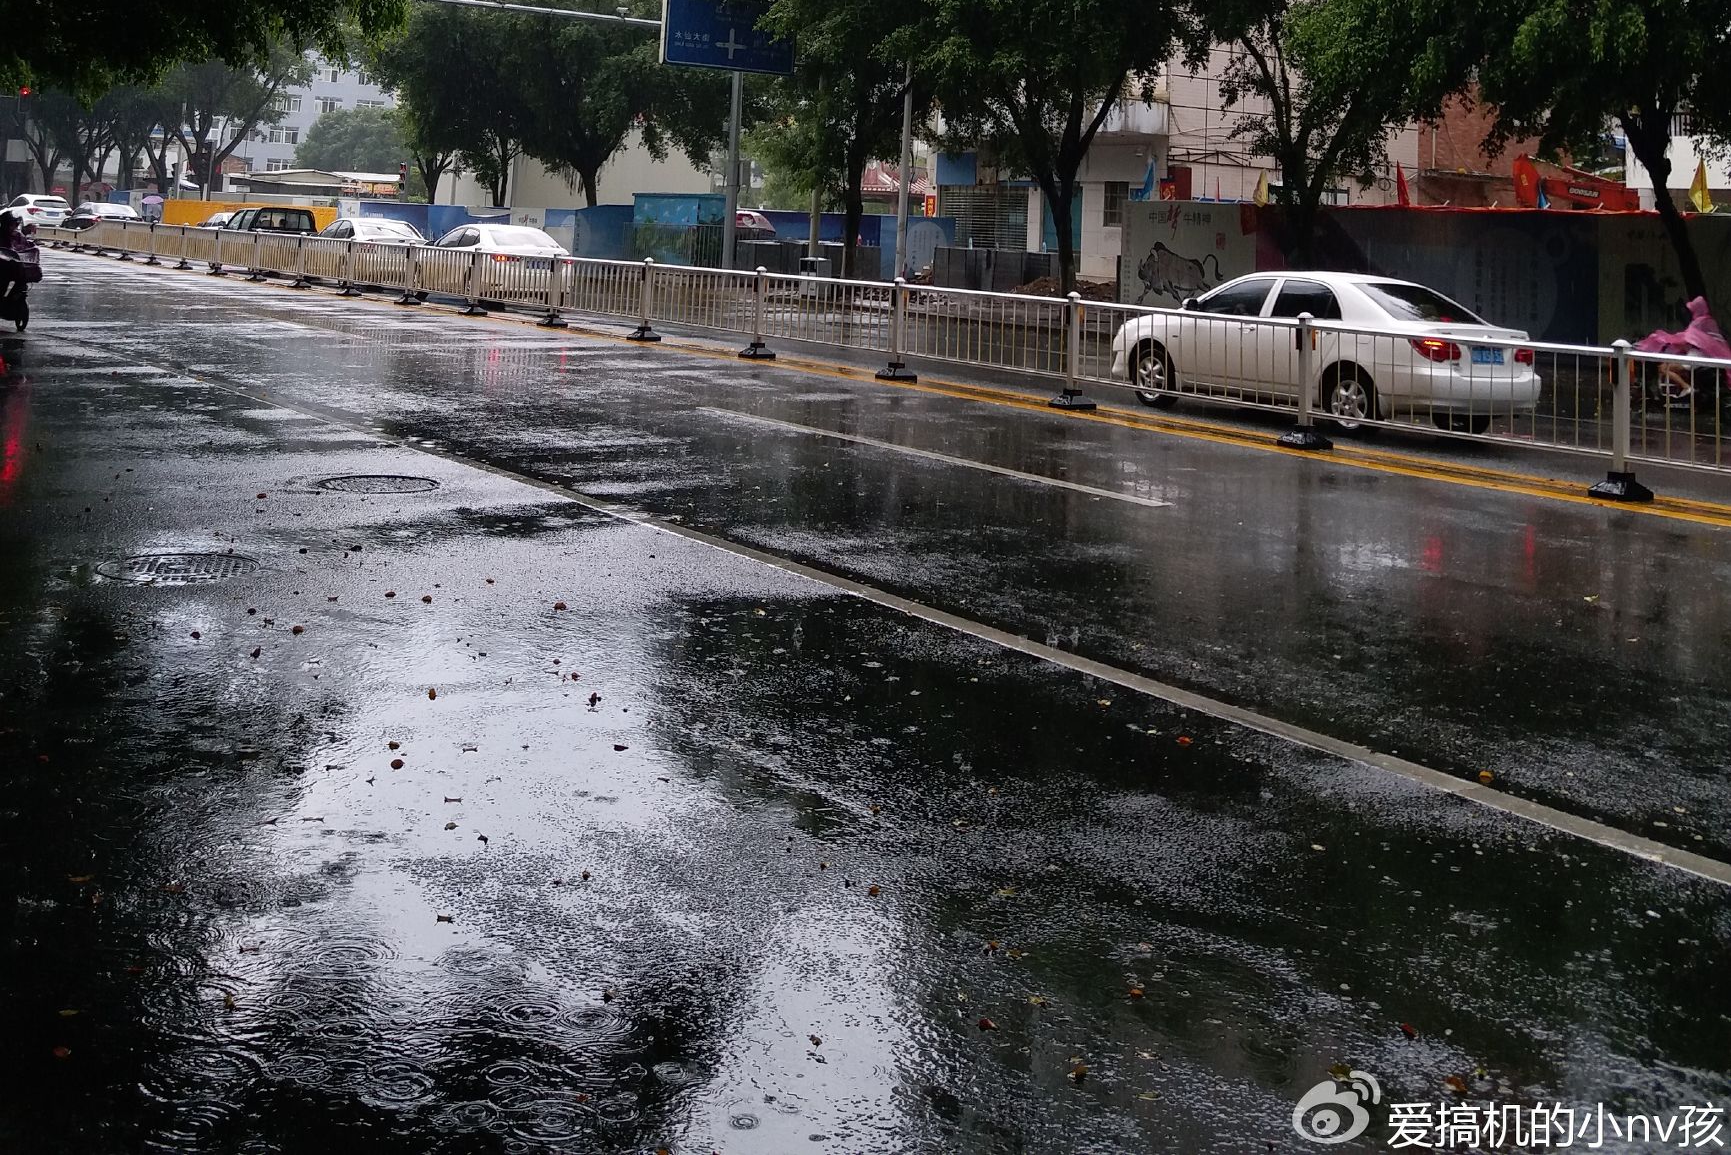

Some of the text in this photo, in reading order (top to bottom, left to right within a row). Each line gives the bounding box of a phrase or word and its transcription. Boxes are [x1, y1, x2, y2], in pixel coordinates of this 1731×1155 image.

[1569, 186, 1600, 198] DOOSAN
[1183, 212, 1212, 226] 牛精神
